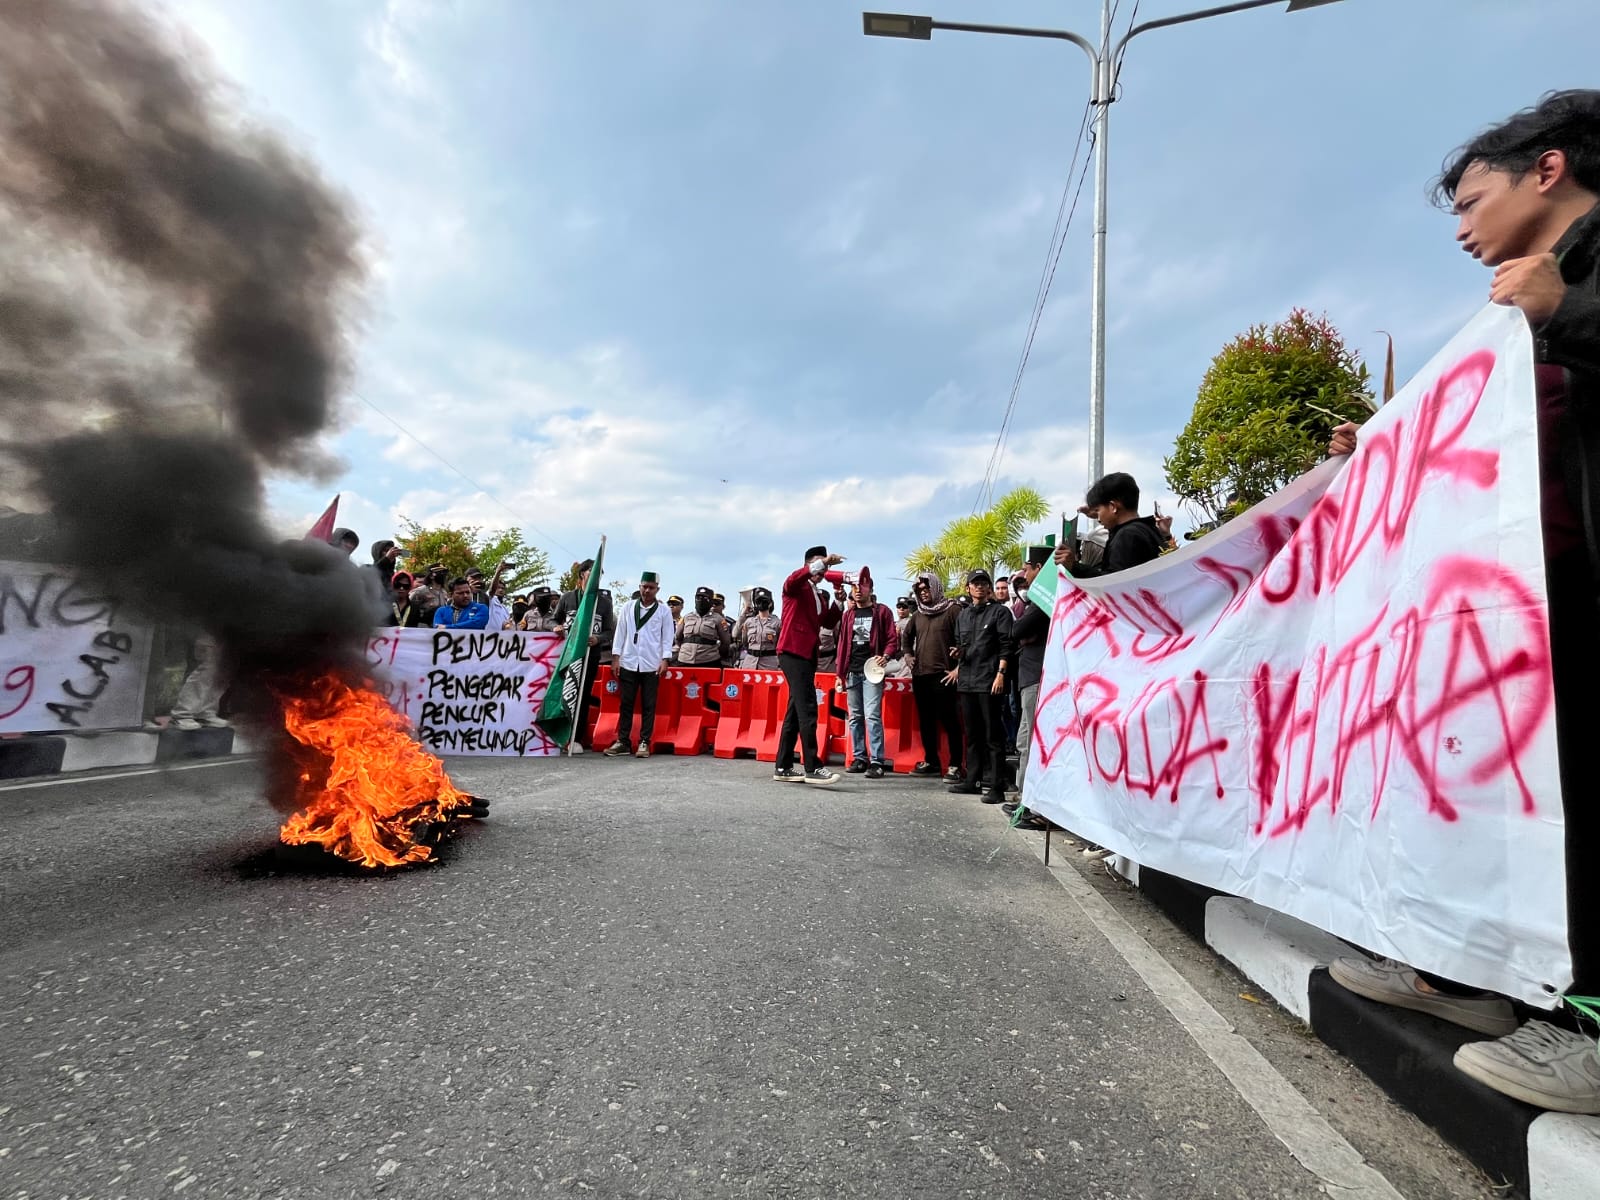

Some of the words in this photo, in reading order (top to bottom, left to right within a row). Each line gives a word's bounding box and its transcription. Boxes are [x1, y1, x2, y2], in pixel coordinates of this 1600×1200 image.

[432, 631, 530, 665] PENJUAL
[427, 670, 525, 702] PENGEDAR
[420, 702, 505, 726] PENCURI
[418, 728, 537, 757] PENYELUNDUP
